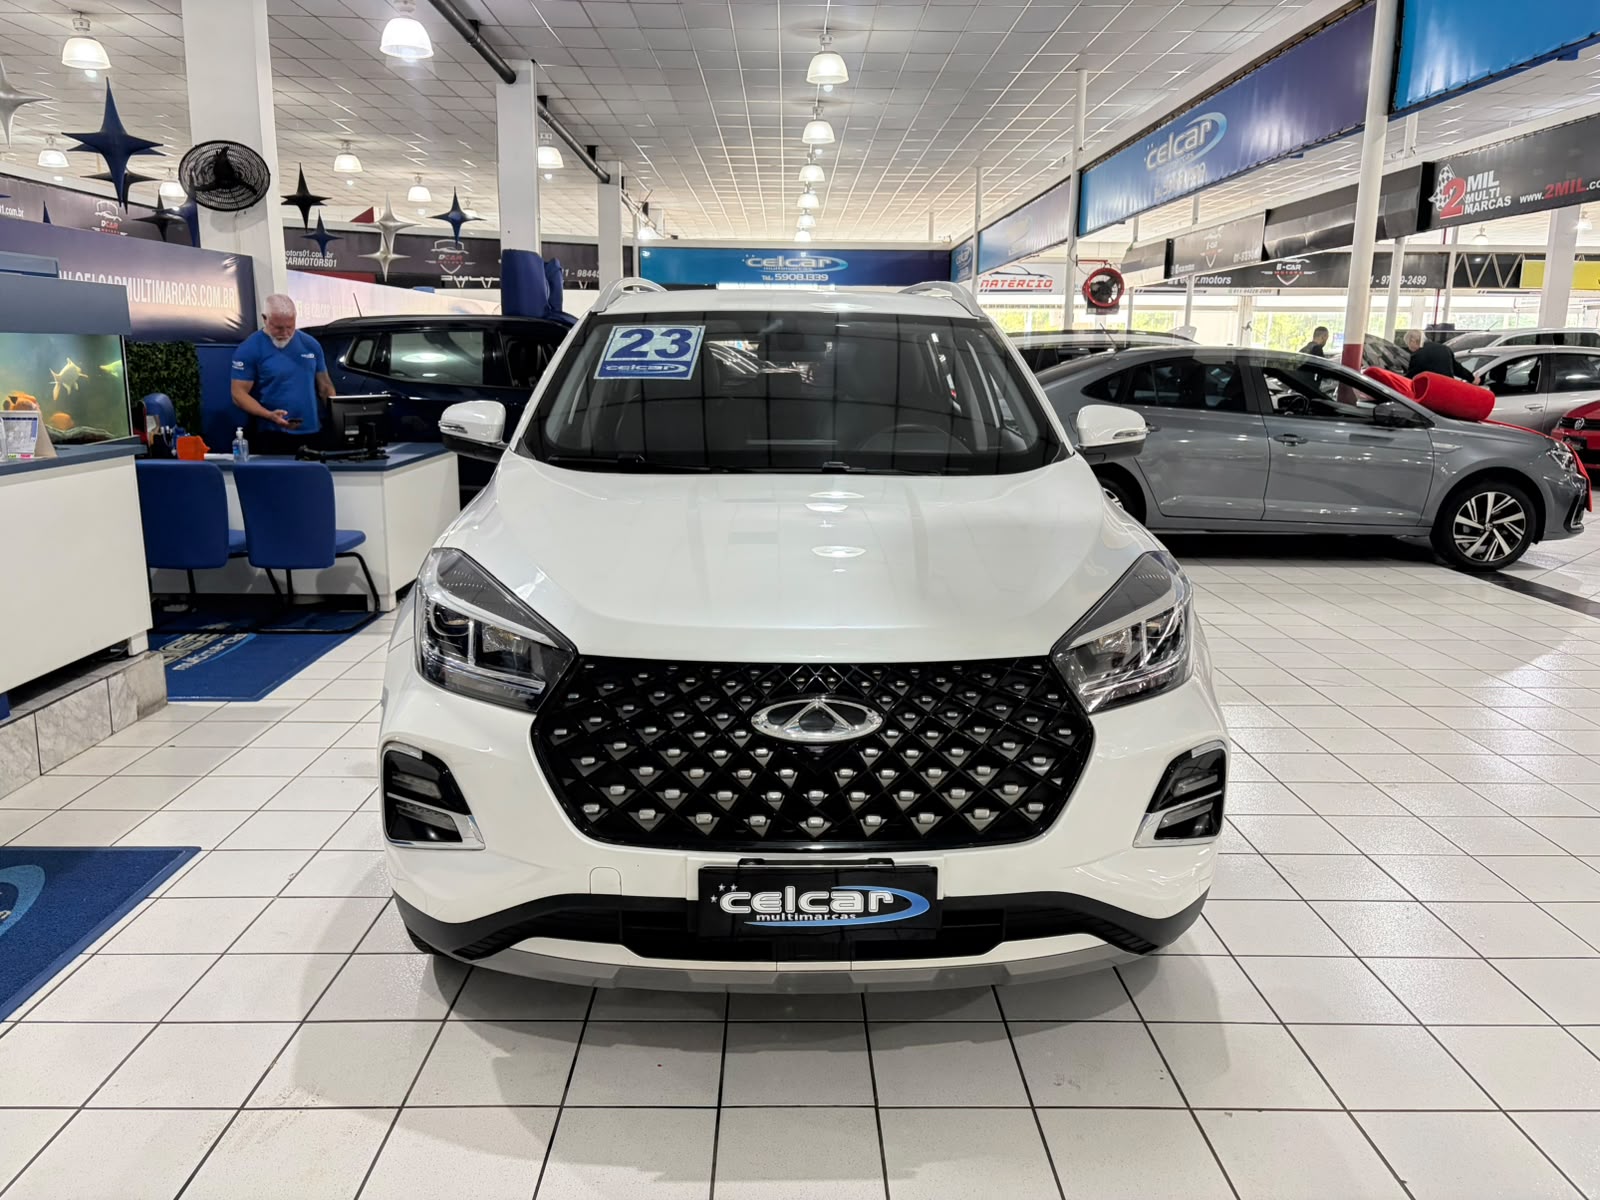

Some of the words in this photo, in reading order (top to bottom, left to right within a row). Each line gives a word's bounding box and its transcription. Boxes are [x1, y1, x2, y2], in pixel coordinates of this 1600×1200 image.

[1440, 177, 1467, 220] 2
[1467, 170, 1500, 192] MIL
[1464, 195, 1512, 214] MARCAS
[1465, 187, 1501, 204] MULTI
[611, 328, 693, 359] 23
[719, 885, 894, 914] celcar
[756, 912, 857, 922] multimarcas
